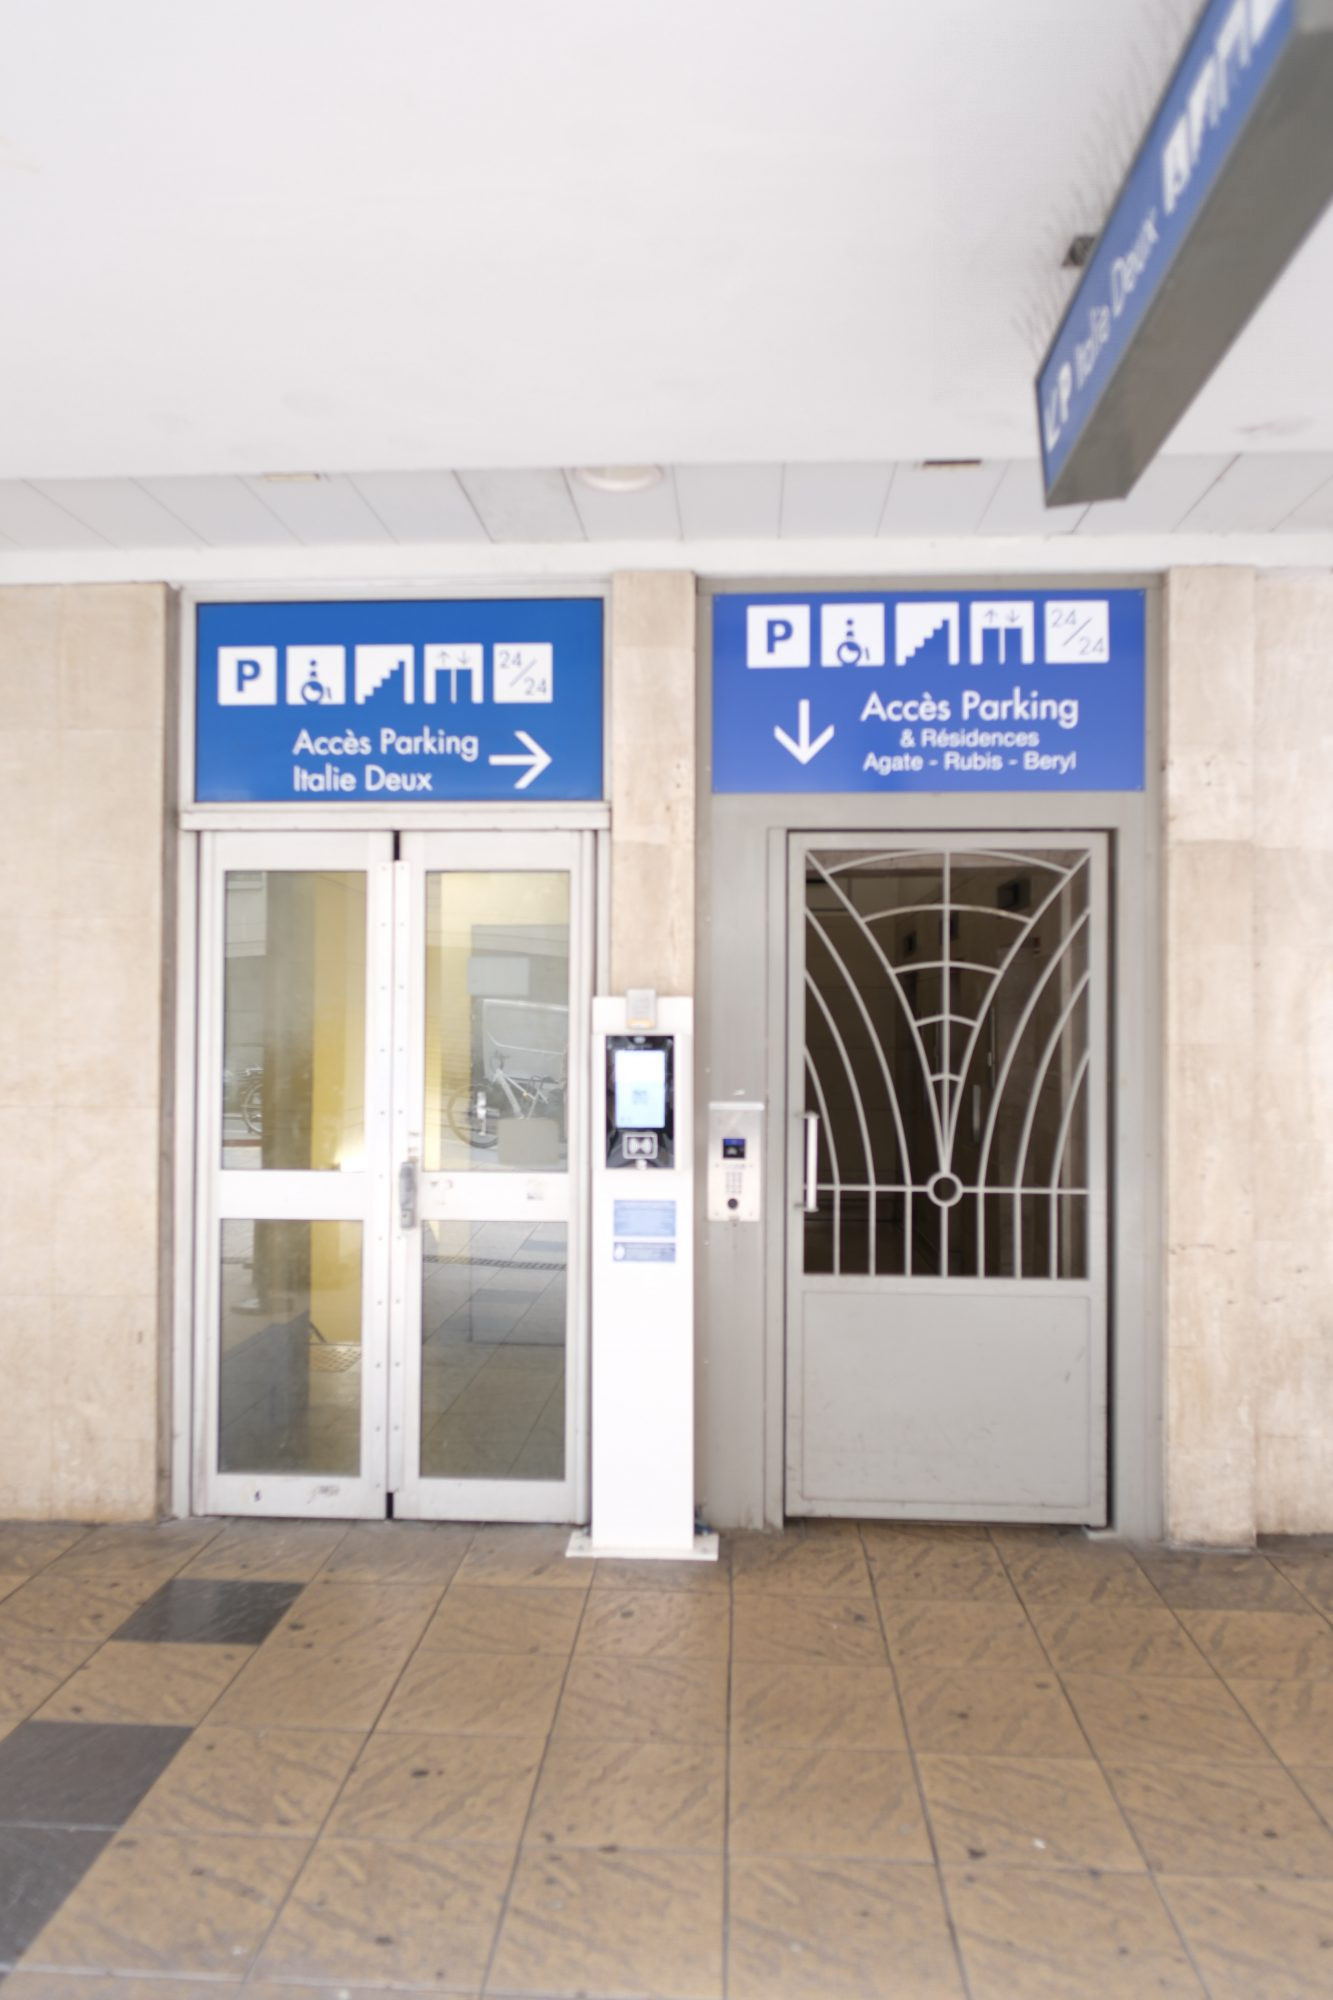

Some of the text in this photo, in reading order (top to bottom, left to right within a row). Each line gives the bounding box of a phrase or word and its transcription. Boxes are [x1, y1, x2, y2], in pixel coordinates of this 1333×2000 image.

[766, 619, 794, 655] P
[235, 659, 262, 693] P
[860, 686, 1079, 729] Accès Parking
[292, 726, 479, 762] Accès Parking
[899, 727, 1040, 748] & Résidences
[293, 763, 434, 792] Italie Deux
[862, 751, 924, 775] Agate
[943, 750, 1004, 771] Rubis
[1022, 750, 1077, 774] Beryl
